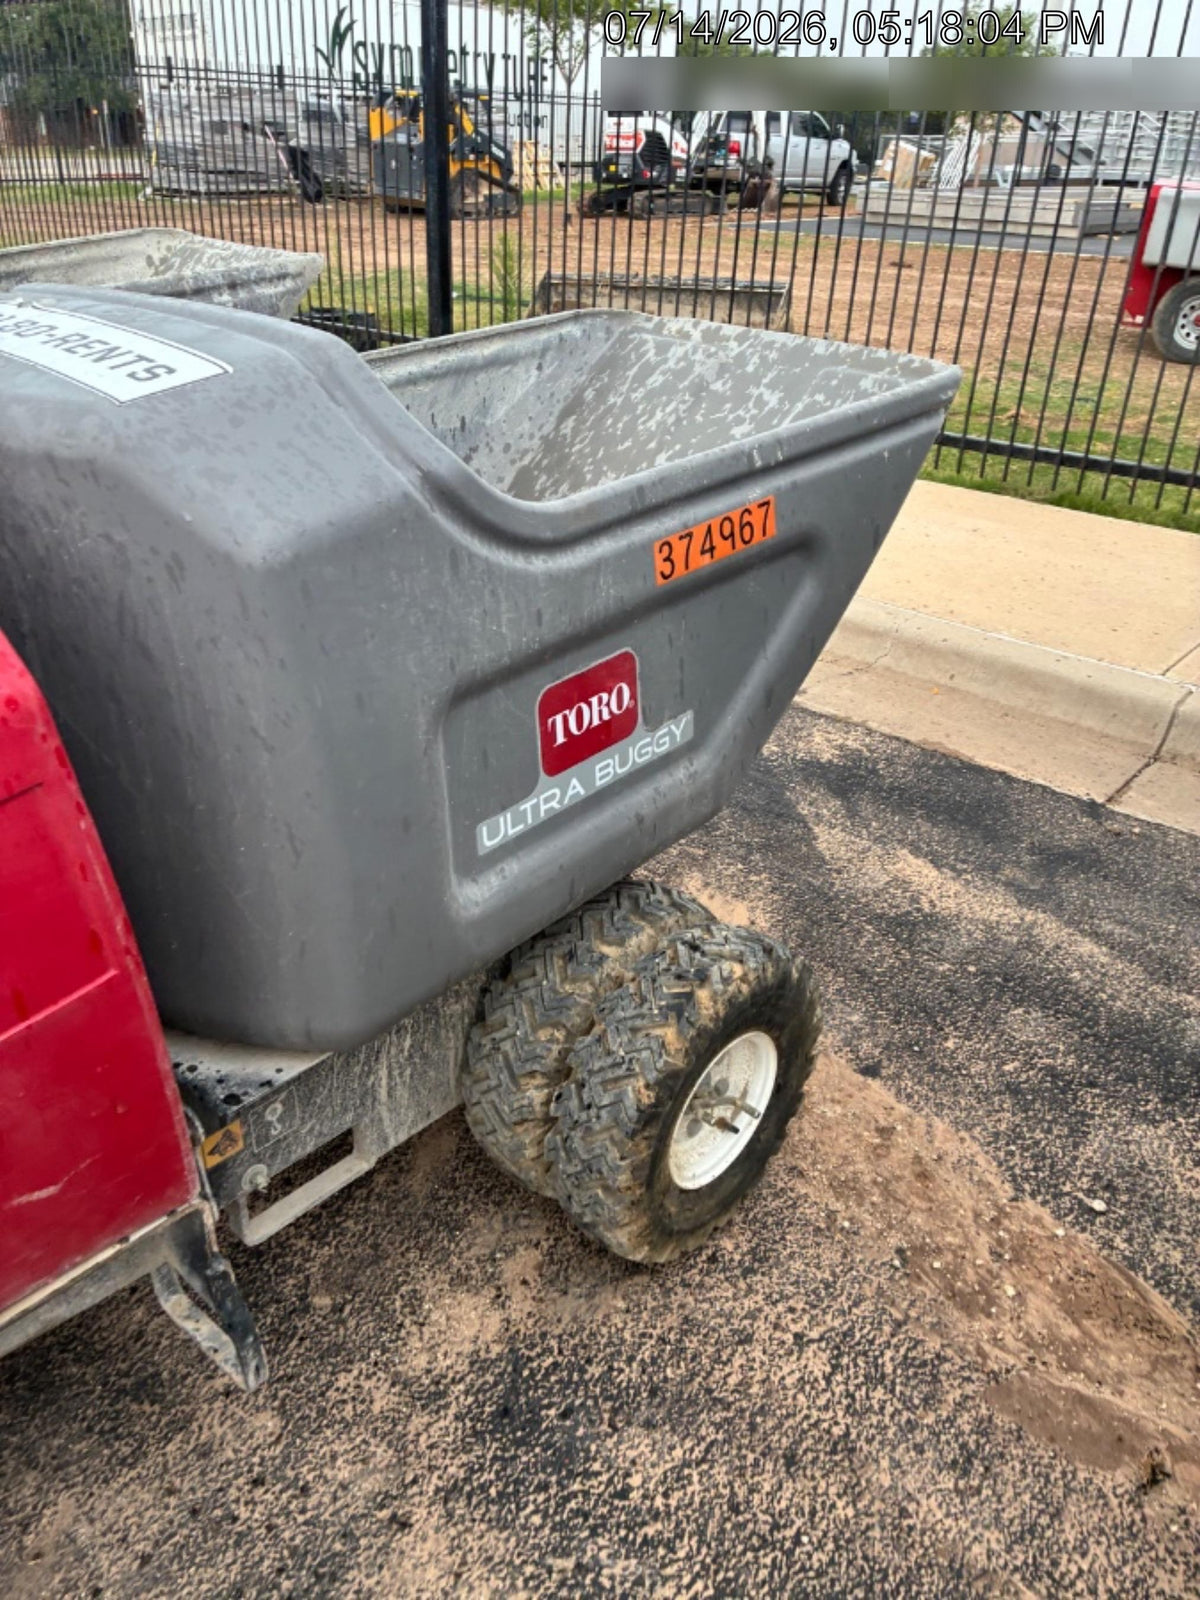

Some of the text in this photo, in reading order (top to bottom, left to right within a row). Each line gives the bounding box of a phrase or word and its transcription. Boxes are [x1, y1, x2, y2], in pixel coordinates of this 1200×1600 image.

[658, 499, 771, 580] 374967
[547, 682, 631, 748] TORO
[482, 716, 689, 847] ULTRA BUGGY
